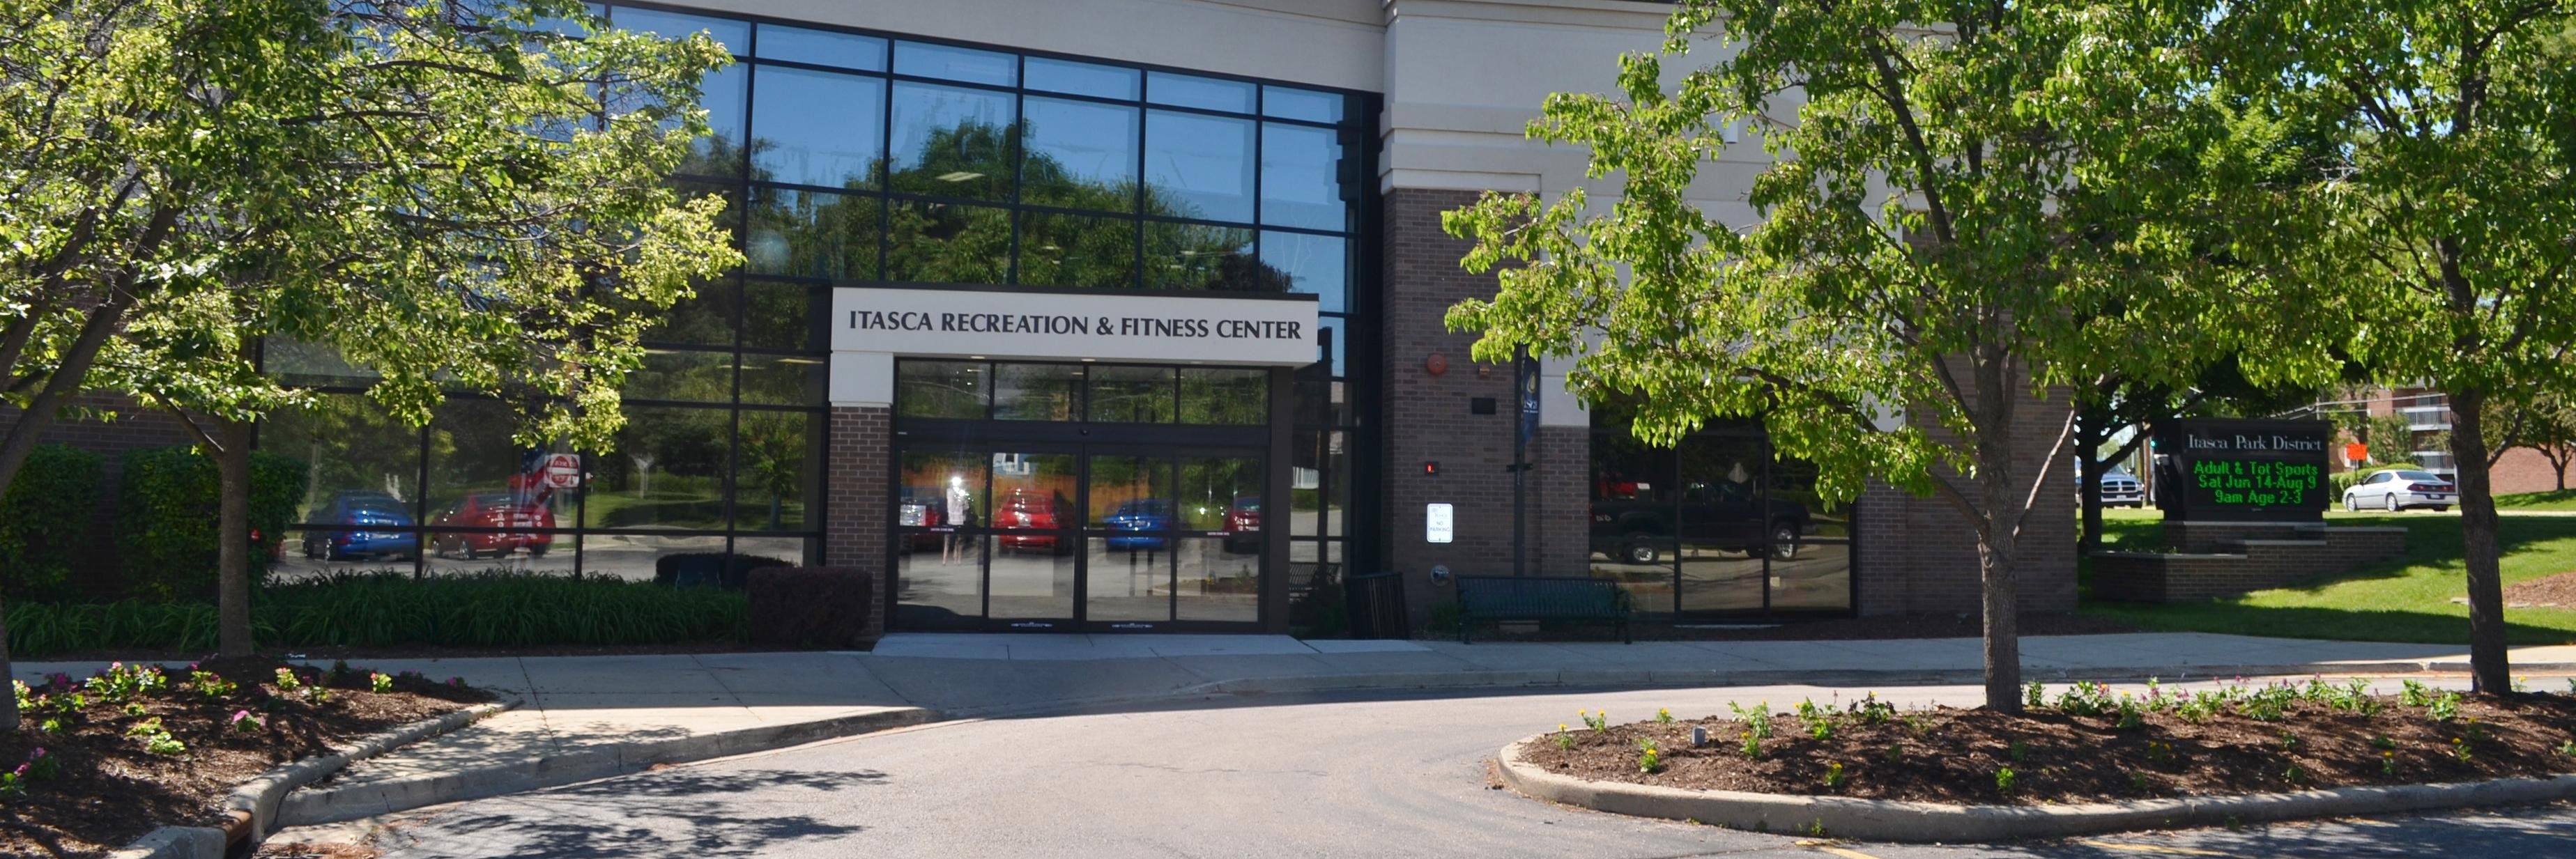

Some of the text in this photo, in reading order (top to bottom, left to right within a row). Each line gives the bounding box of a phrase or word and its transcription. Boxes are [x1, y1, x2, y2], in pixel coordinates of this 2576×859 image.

[850, 311, 1301, 339] ITASCA RECREATION & FITNESS CENTER
[2188, 434, 2322, 451] Itasca Park District
[2194, 461, 2318, 477] Adult & Tot Sports
[2199, 474, 2316, 490] Sat Jun 14-Aug 9
[2215, 490, 2301, 506] 9am Age 2-3
